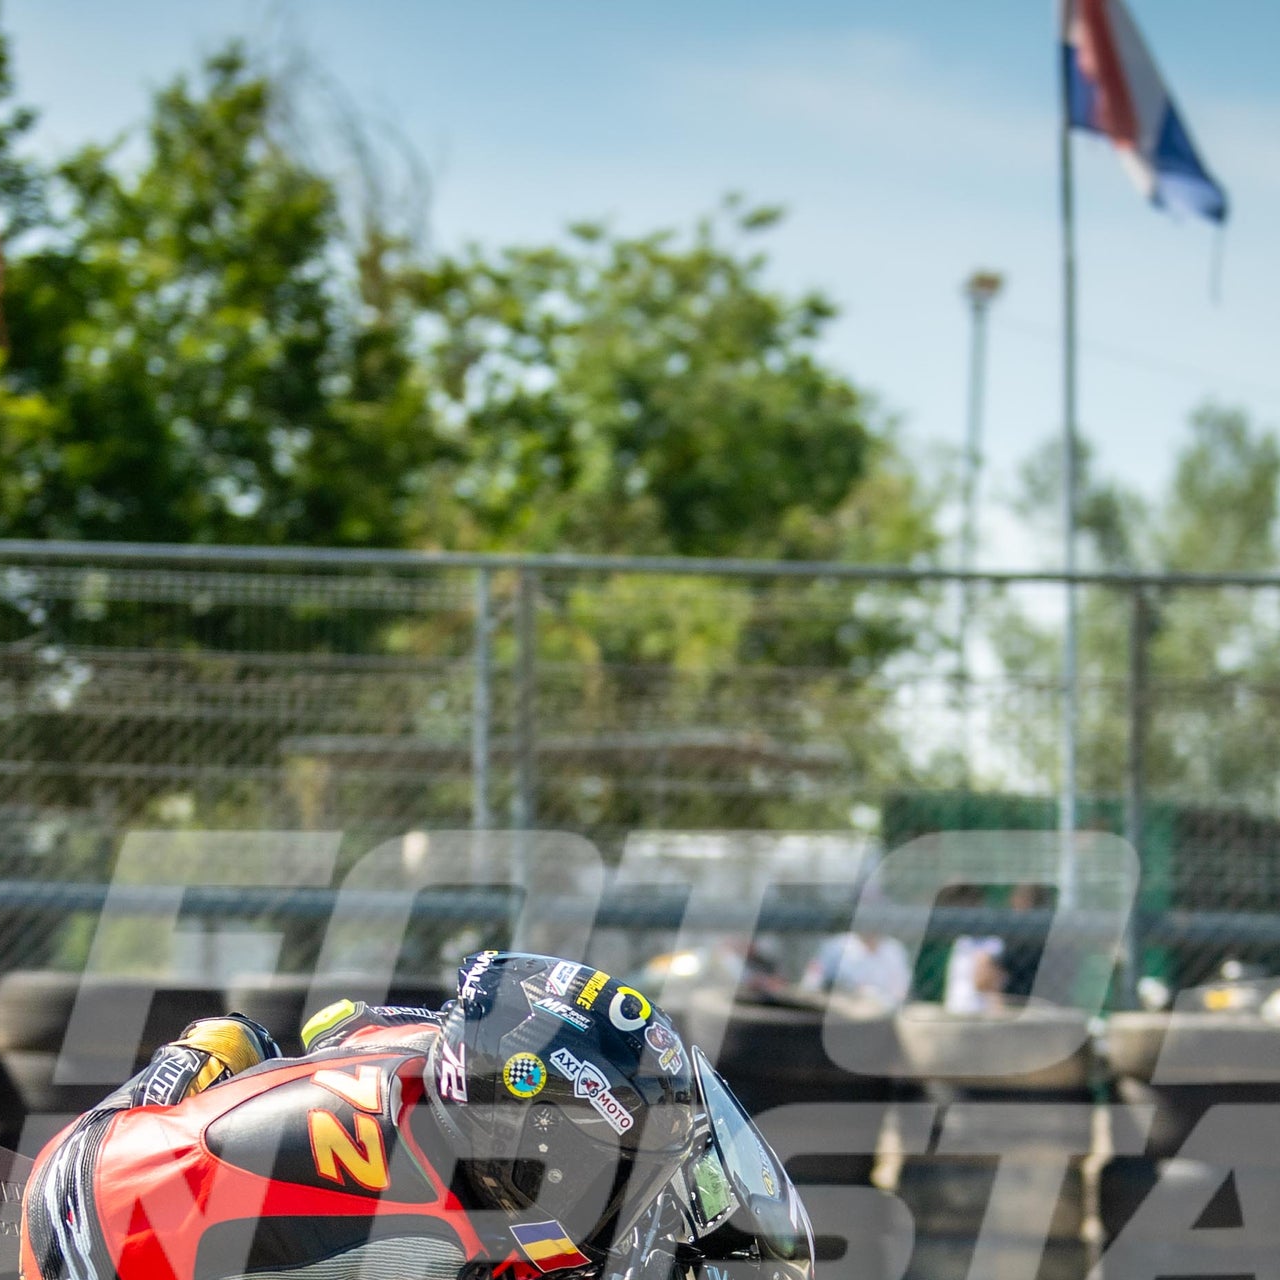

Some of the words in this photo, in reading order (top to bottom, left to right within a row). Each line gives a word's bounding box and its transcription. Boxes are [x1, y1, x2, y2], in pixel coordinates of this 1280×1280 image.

[535, 997, 574, 1016] MF
[566, 1008, 591, 1025] SPORT
[441, 1041, 468, 1104] 72
[554, 1051, 579, 1075] AXI
[308, 1064, 390, 1191] 72
[596, 1092, 631, 1130] MOTO
